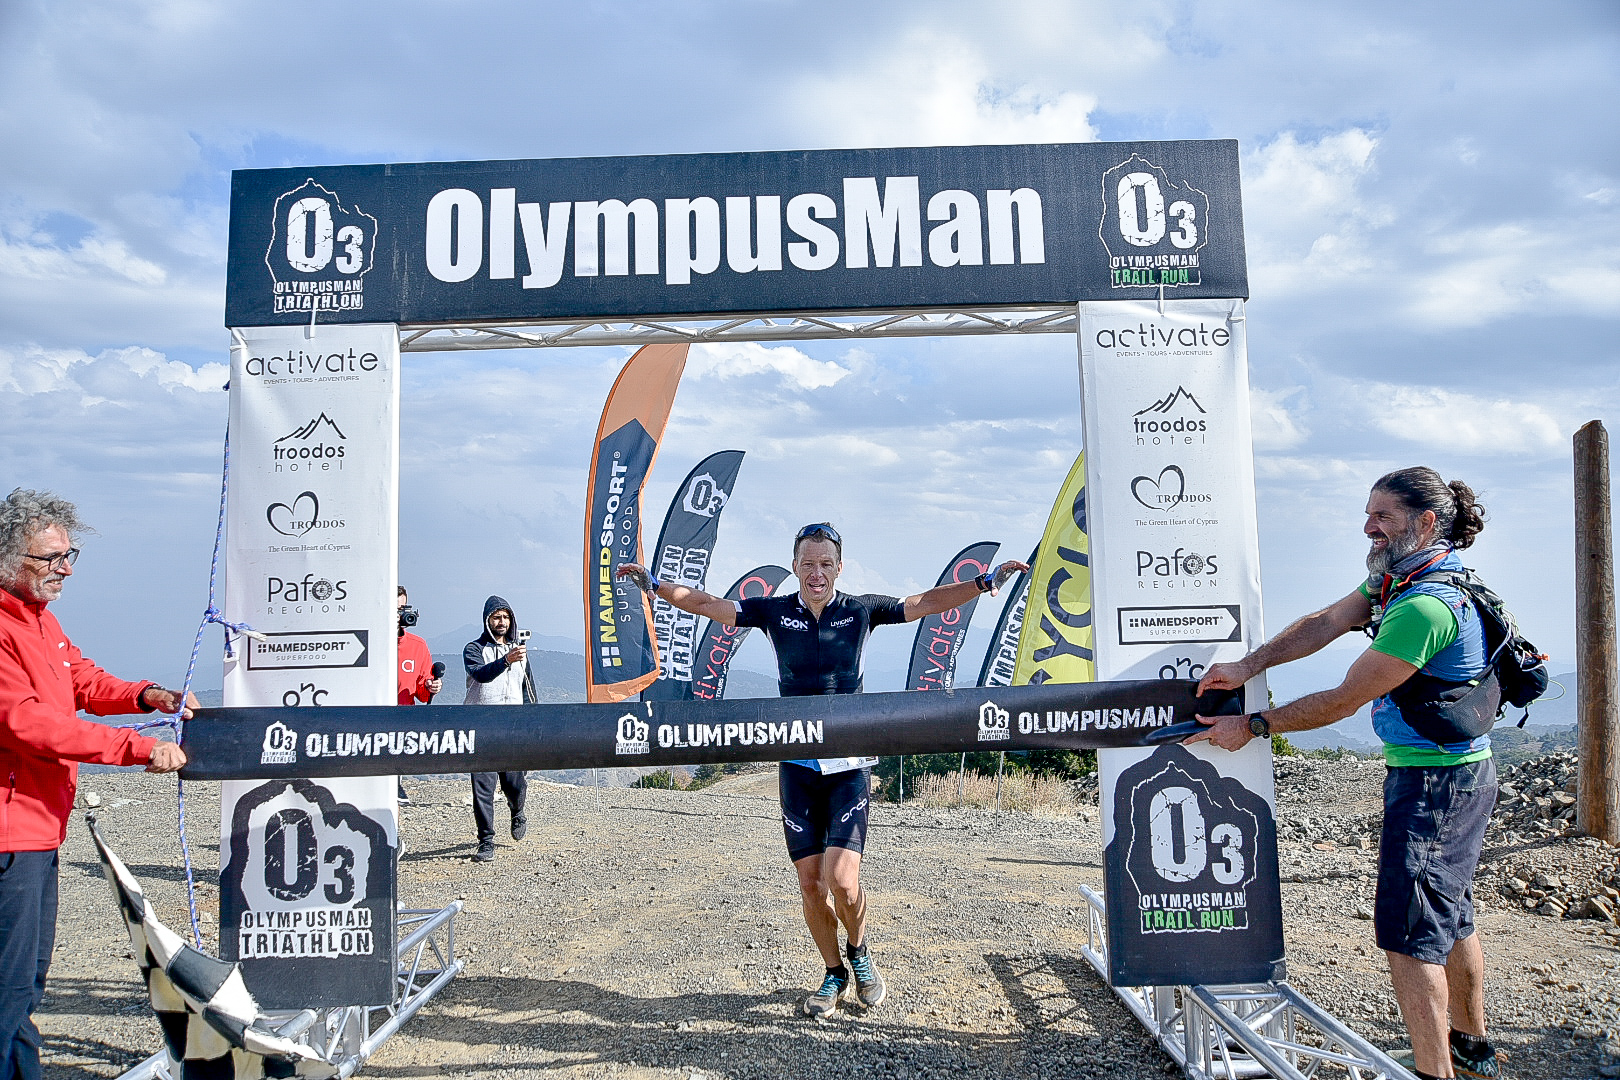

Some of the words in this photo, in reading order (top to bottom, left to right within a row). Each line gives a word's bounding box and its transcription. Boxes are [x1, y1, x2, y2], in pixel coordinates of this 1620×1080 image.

[426, 176, 1046, 289] OlympusMan
[1112, 254, 1197, 268] OLYMPUSMAN
[1113, 268, 1155, 284] TRAIL
[1160, 268, 1189, 284] RUN
[276, 280, 361, 293] OLYMPUSMAN
[276, 294, 361, 310] TRIATHLON
[1096, 322, 1230, 348] activate
[246, 348, 378, 376] activate
[1134, 417, 1207, 433] troodos
[1136, 434, 1205, 445] hotel
[274, 443, 345, 460] troodos
[275, 460, 343, 472] hotel
[1156, 494, 1212, 503] TROODOS
[290, 520, 345, 530] TROODOS
[1196, 518, 1218, 527] Cyprus
[268, 545, 280, 553] The
[281, 545, 300, 553] Green
[301, 544, 318, 552] Heart
[328, 543, 351, 553] Cyprus
[1137, 548, 1218, 577] Pafos
[267, 573, 347, 603] Pafos
[1138, 580, 1217, 589] REGION
[267, 605, 346, 615] REGION
[1149, 628, 1201, 636] SUPERFOOD
[276, 653, 327, 661] SUPERFOOD
[1018, 706, 1174, 734] OLUMPUSMAN
[657, 720, 823, 748] OLUMPUSMAN
[305, 730, 476, 758] OLUMPUSMAN
[1142, 891, 1244, 908] OLYMPUSMAN
[244, 910, 369, 929] OLYMPUSMAN
[1144, 911, 1194, 928] TRAIL
[1201, 910, 1234, 928] RUN
[242, 931, 370, 955] TRIATHLON
